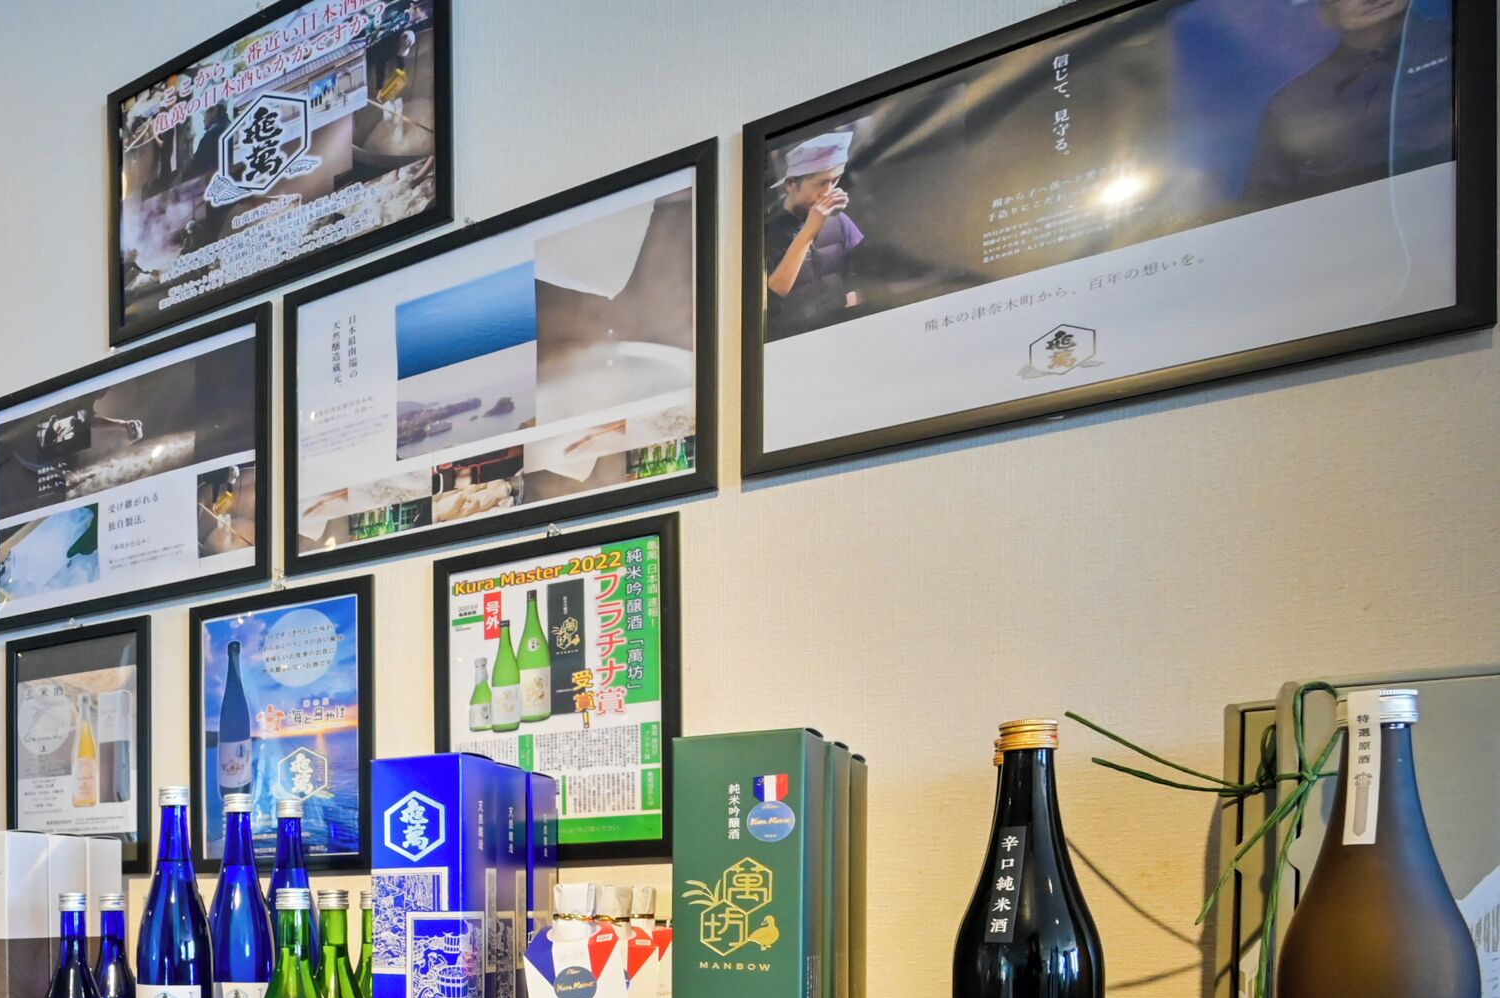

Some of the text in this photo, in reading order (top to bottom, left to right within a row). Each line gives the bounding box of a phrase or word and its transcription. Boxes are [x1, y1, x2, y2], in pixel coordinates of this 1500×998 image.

[162, 0, 372, 106] ここから一番近い日本酒
[1052, 53, 1070, 155] 信じて、 見守る。
[454, 551, 623, 597] Kura Master 2022
[485, 600, 501, 631] 号外
[594, 566, 628, 716] プラチナ賞
[571, 668, 596, 729] 受賞!
[1355, 713, 1373, 766] 特選原酒
[727, 783, 741, 840] 純米吟醸酒
[989, 833, 1020, 934] 辛口純米酒
[699, 960, 772, 972] MANBOW
